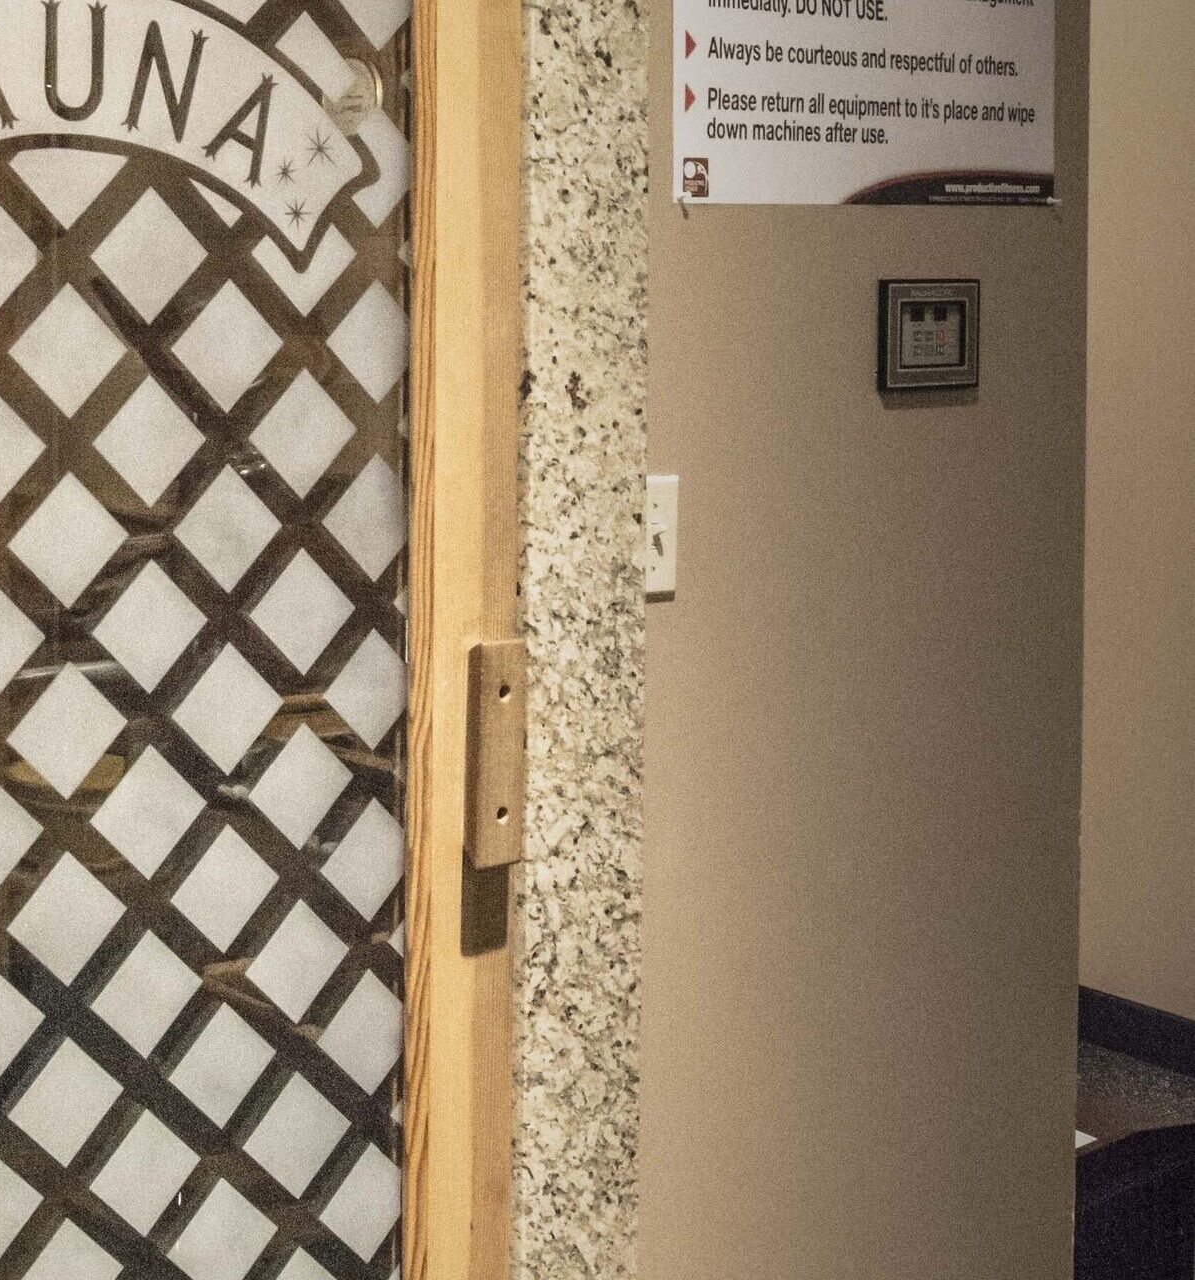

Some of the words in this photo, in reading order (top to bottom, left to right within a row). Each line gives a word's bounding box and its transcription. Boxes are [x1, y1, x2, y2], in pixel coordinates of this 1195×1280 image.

[707, 36, 761, 66] Always
[765, 40, 784, 63] be
[787, 44, 858, 68] courteous
[861, 48, 887, 69] and
[889, 51, 956, 76] respectful
[958, 53, 973, 75] of
[975, 55, 1019, 77] others.
[707, 86, 757, 112] Please
[761, 92, 805, 113] return
[808, 92, 825, 114] all
[828, 97, 902, 121] equipment
[904, 98, 918, 119] to
[921, 97, 940, 120] it's
[943, 99, 979, 124] place
[981, 101, 1005, 122] and
[1007, 106, 1036, 127] wipe
[706, 117, 748, 140] down
[752, 119, 822, 143] machines
[824, 121, 858, 144] after
[861, 127, 889, 145] use.
